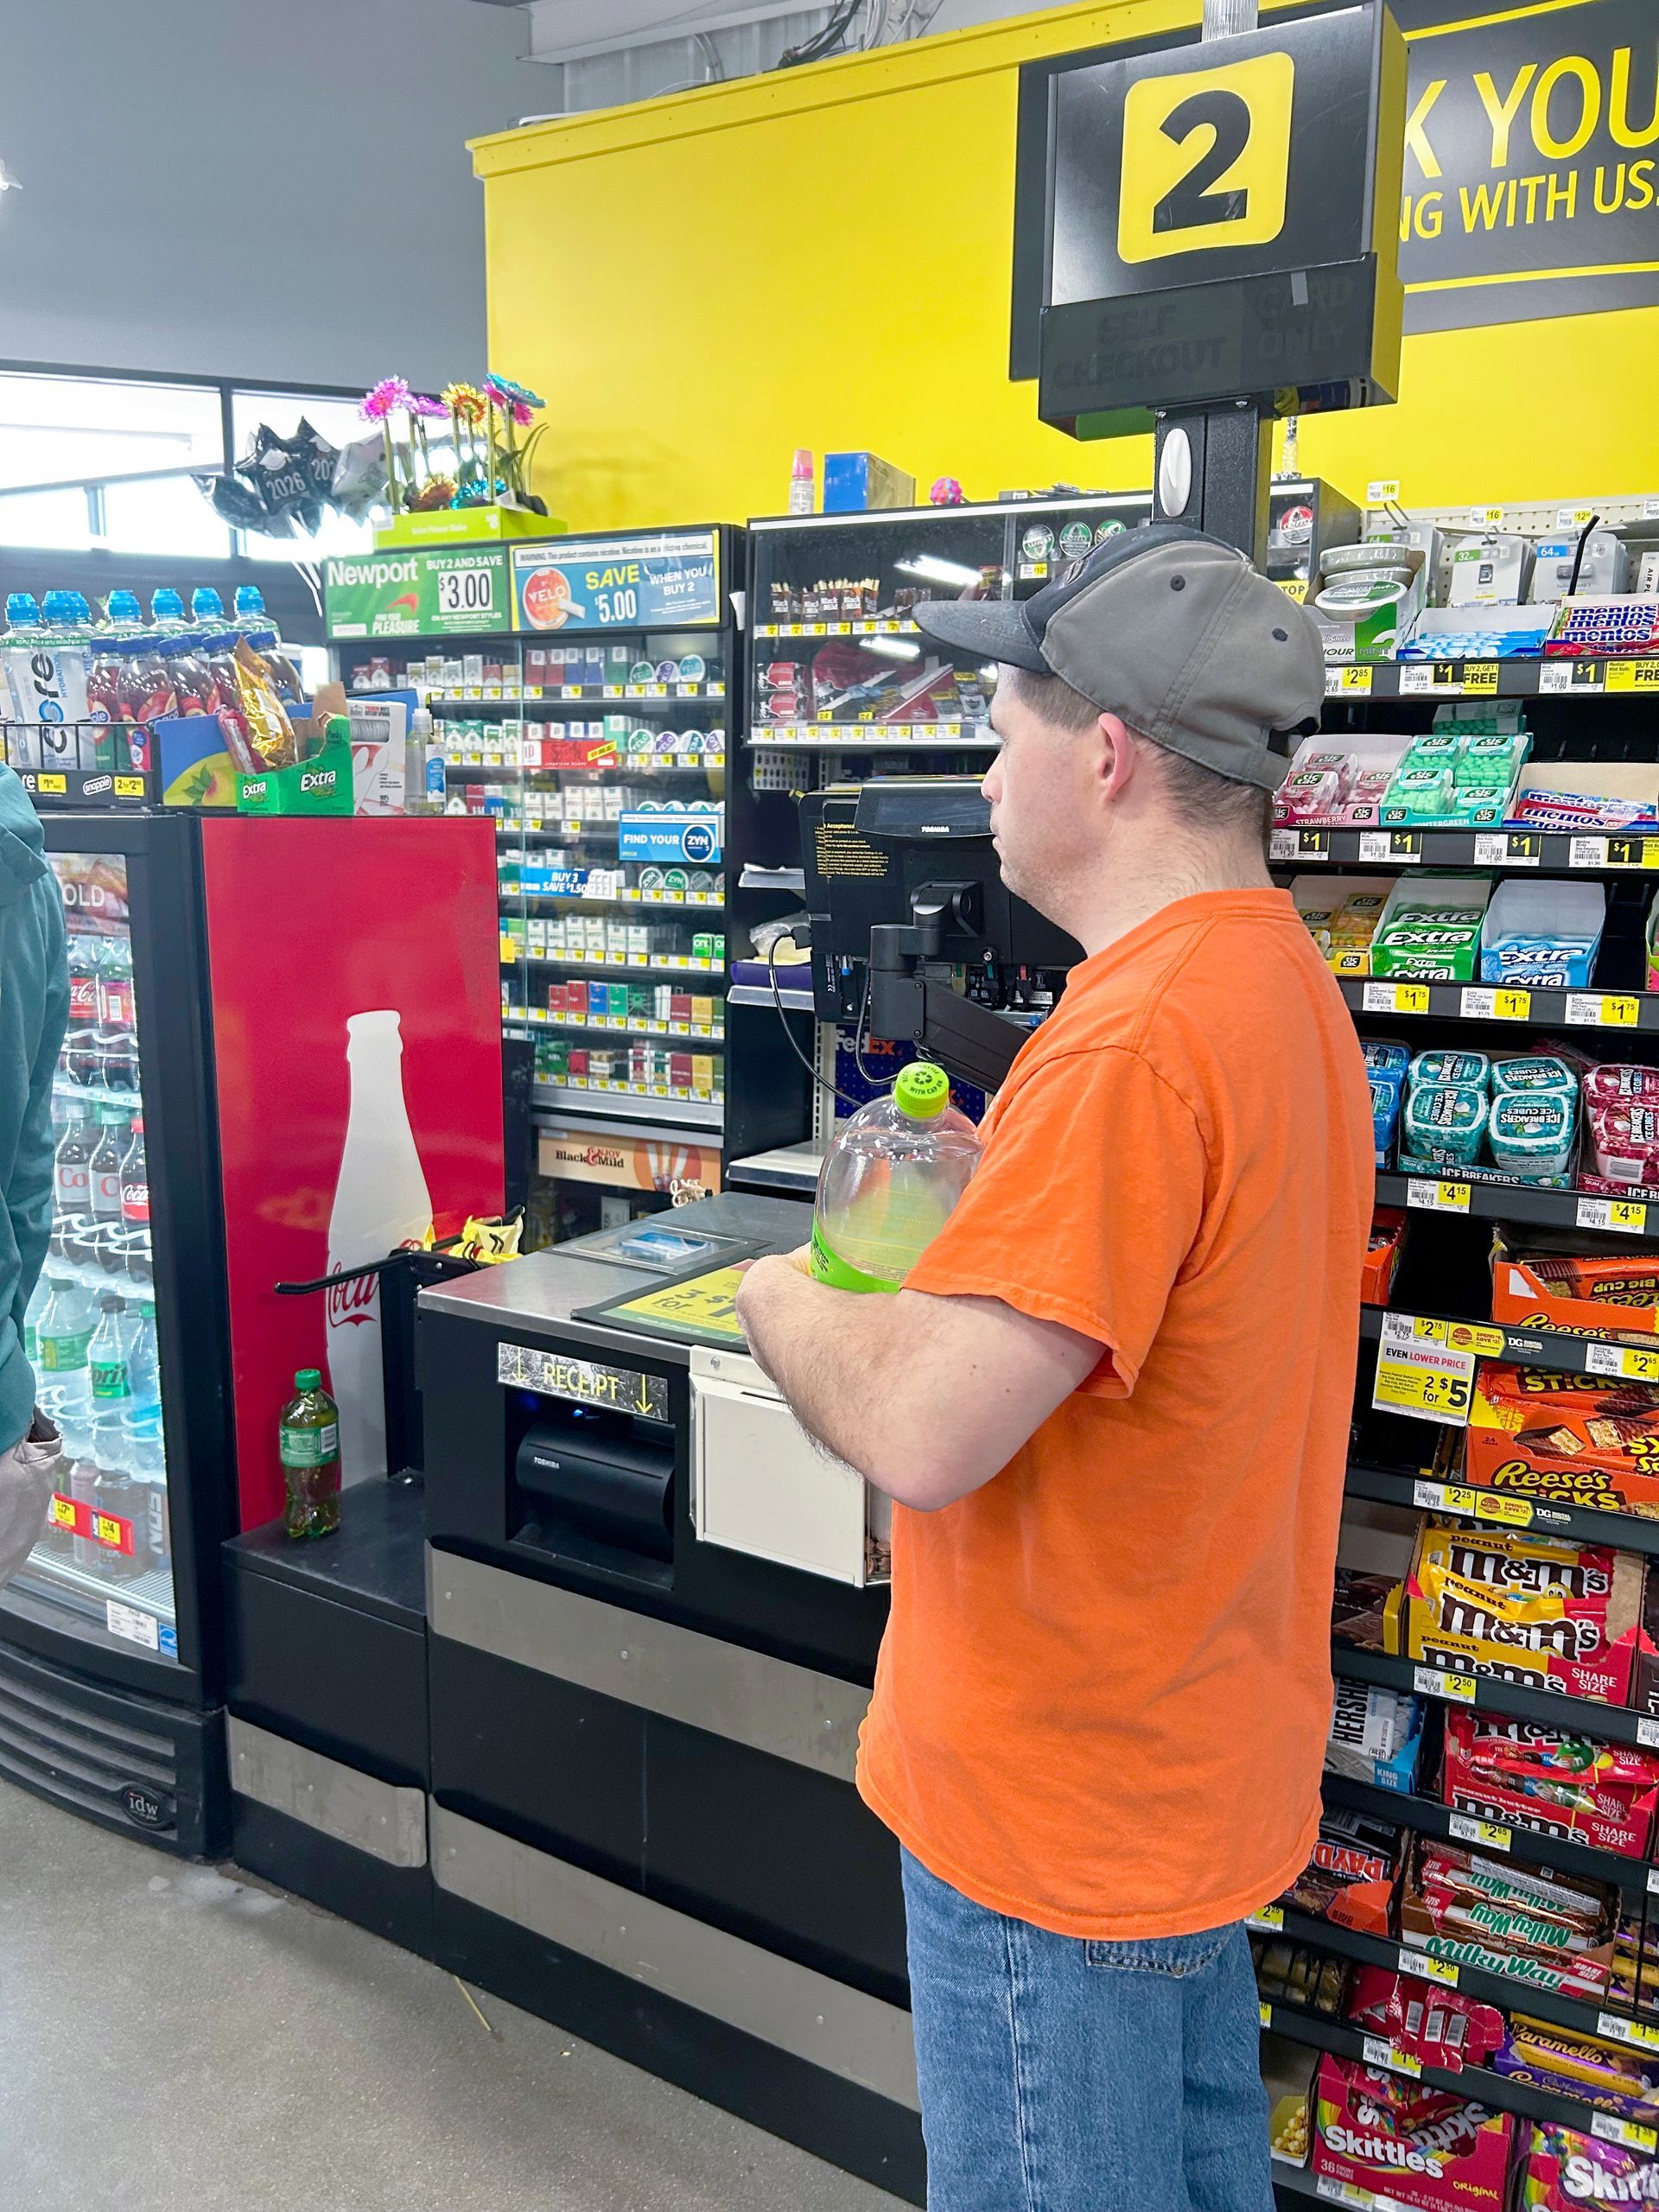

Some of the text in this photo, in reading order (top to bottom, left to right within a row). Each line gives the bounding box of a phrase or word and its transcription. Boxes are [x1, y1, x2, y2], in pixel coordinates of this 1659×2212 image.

[1473, 48, 1659, 168] YOU
[1153, 90, 1251, 233] 2
[1459, 170, 1576, 233] WITH
[1593, 159, 1659, 214] US.
[266, 472, 306, 499] 2026
[1486, 511, 1500, 519] $16
[558, 550, 577, 561] product
[1459, 552, 1469, 561] 32
[1541, 548, 1554, 556] 64
[426, 559, 445, 570] BUY
[454, 558, 474, 569] AND
[476, 556, 503, 568] SAVE
[327, 557, 418, 588] Newport
[585, 564, 639, 589] SAVE
[650, 567, 706, 585] WHEN YOU
[439, 573, 490, 608] $3.00
[527, 586, 566, 602] VELO
[663, 582, 695, 595] BUY 2
[595, 589, 637, 623] $5.00
[1573, 605, 1657, 614] mentos
[1569, 618, 1655, 628] mentos
[1572, 612, 1656, 621] mentos
[372, 620, 419, 634] PLEASURE
[1564, 628, 1651, 642] mentos
[1359, 647, 1389, 656] MINT
[1439, 664, 1452, 683] $1
[1464, 673, 1497, 684] FREE
[1577, 664, 1595, 683] $1
[84, 776, 111, 794] snapple
[243, 780, 266, 799] Extra
[300, 770, 336, 792] Extra
[1296, 816, 1346, 825] STRAWBERRY
[1523, 808, 1605, 826] mentos
[624, 835, 709, 846] FIND YOUR ZYN
[1303, 833, 1319, 851] $1
[1395, 834, 1412, 853] $1
[1512, 836, 1530, 856] $1
[1614, 842, 1630, 862] $1
[552, 872, 571, 881] BUY
[543, 883, 565, 893] SAVE
[1396, 911, 1481, 923] Extra
[1383, 931, 1473, 945] Extra
[1499, 950, 1586, 964] Extra
[1504, 1071, 1548, 1081] BREAKERS
[1430, 1100, 1442, 1122] CUBES
[1438, 1098, 1455, 1125] BREAKERS
[1500, 1114, 1560, 1123] ICE BREAKERS
[1630, 1108, 1646, 1143] ICE BREAKERS
[1645, 1111, 1654, 1130] CUBES
[556, 1150, 624, 1168] Black Mild
[1462, 1169, 1520, 1185] BREAKERS
[1594, 1279, 1656, 1293] BIG CUP
[652, 1289, 708, 1310] 3 for
[1508, 1338, 1523, 1347] DG
[1386, 1347, 1466, 1370] EVEN LOWER PRICE
[543, 1362, 620, 1401] RECEIPT
[1423, 1376, 1440, 1402] 2 for
[1440, 1377, 1468, 1408] $5
[534, 1457, 560, 1469] TOSHIBA
[1494, 1461, 1609, 1490] Reese's
[1536, 1507, 1551, 1518] DG
[1450, 1534, 1514, 1551] peanut
[1448, 1545, 1609, 1599] m&m's
[1444, 1575, 1507, 1611] peanut
[1440, 1592, 1600, 1664] m&m's
[1421, 1634, 1479, 1652] peanut
[1571, 1668, 1618, 1688] SHARE
[1578, 1677, 1608, 1694] SIZE
[1619, 1756, 1642, 1766] SIZE
[1376, 1768, 1398, 1779] KING
[1381, 1777, 1397, 1787] SIZE
[130, 1792, 157, 1815] idw
[1452, 1785, 1541, 1813] peanut butter
[1591, 1822, 1637, 1842] SHARE
[1598, 1833, 1627, 1847] SIZE
[1470, 1903, 1573, 1948] Milky Way
[1424, 1936, 1564, 1989] Milky Way
[1573, 1962, 1604, 1977] SHARE
[1578, 1970, 1600, 1981] SIZE
[1325, 2125, 1444, 2179] Skittles
[1320, 2160, 1336, 2173] 36
